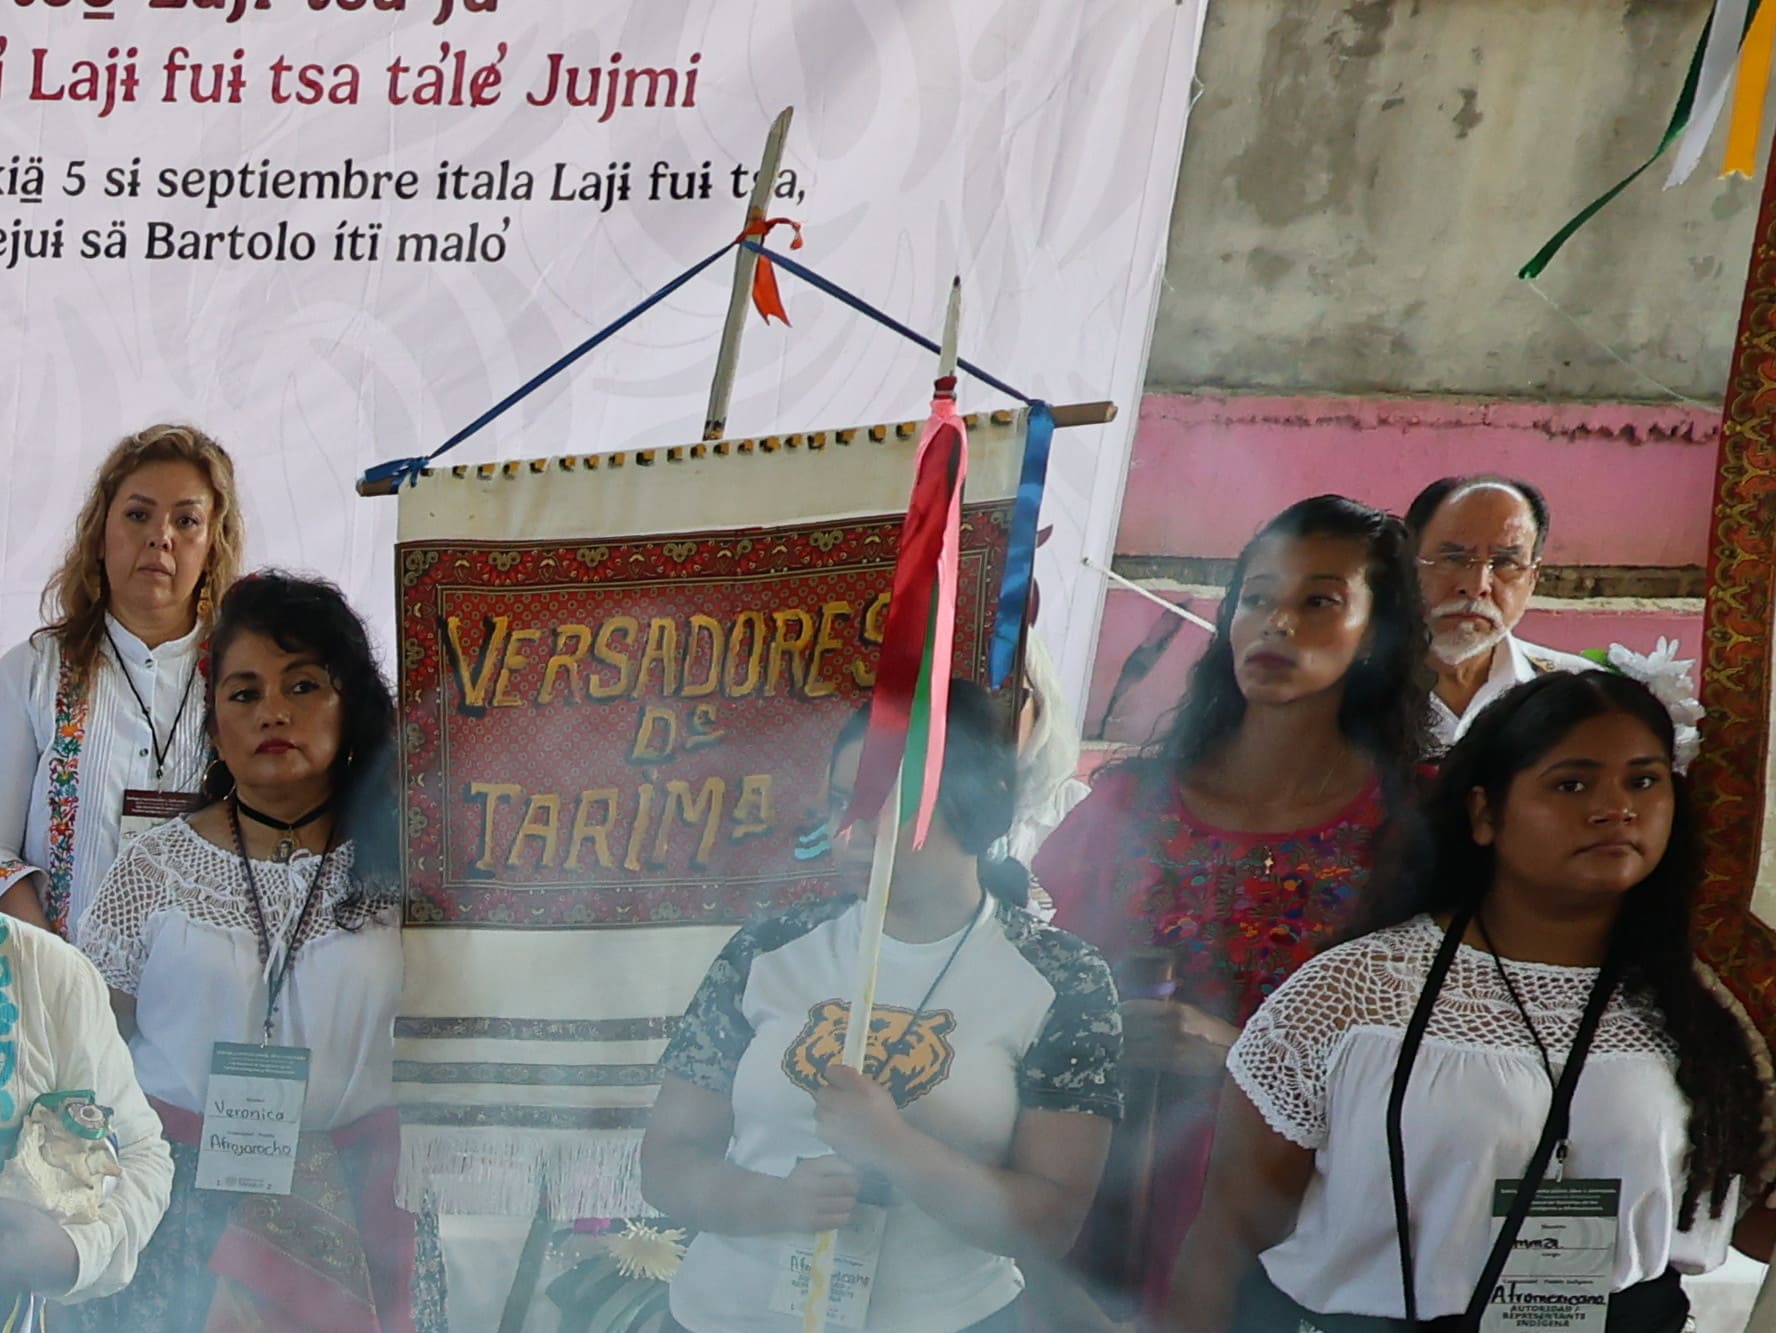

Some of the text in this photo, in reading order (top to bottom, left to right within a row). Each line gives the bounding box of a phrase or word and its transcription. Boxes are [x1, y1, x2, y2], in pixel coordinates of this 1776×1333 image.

[270, 56, 361, 105] tsa
[525, 52, 702, 122] Jujmi
[62, 160, 87, 198] 5
[157, 158, 420, 209] septiembre
[435, 159, 534, 201] itala
[80, 220, 127, 259] sä
[144, 220, 316, 261] Bartolo
